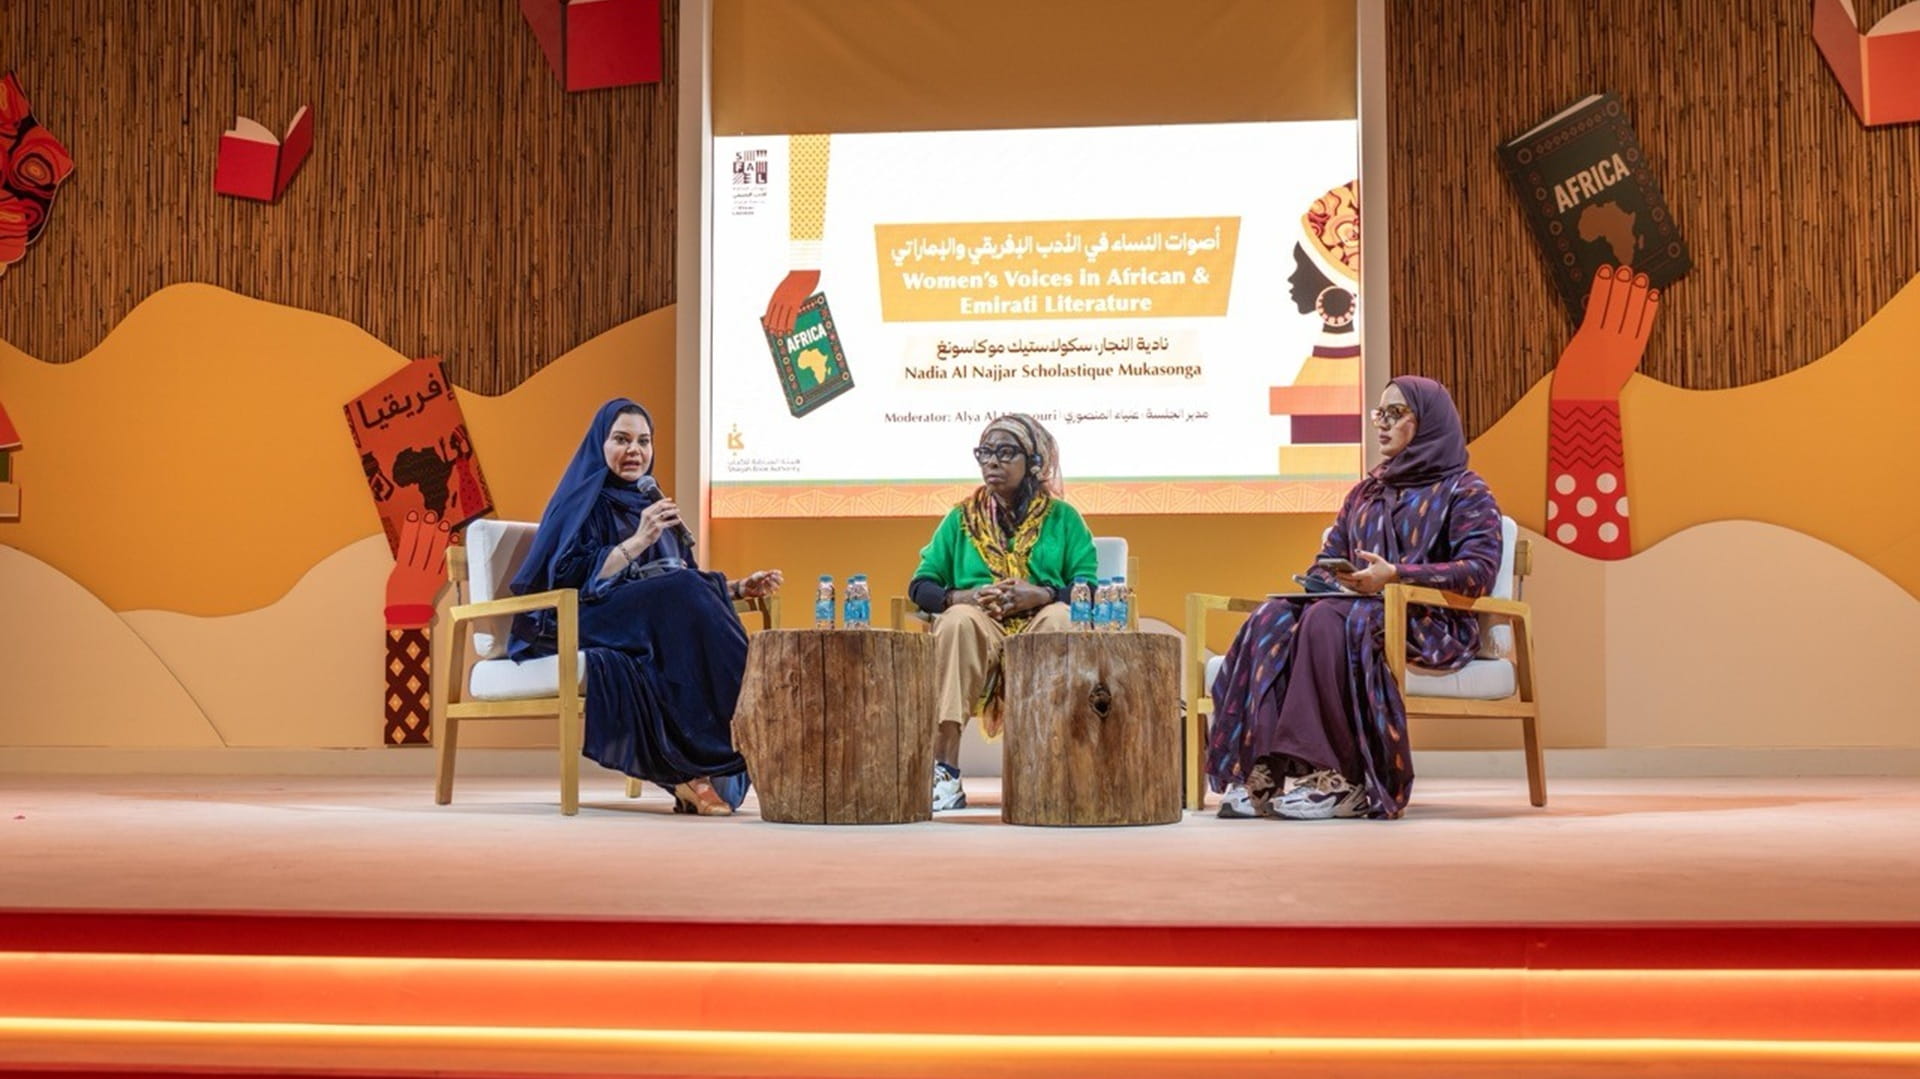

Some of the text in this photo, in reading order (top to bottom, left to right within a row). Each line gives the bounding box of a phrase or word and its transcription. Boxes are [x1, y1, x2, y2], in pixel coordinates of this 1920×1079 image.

[1553, 152, 1631, 214] AFRICA
[890, 224, 1222, 267] أصوات النساء في الأدب الإفريقي والإماراتي
[902, 265, 1210, 290] Women’s Voices in African &
[960, 293, 1153, 314] Emirati Literature
[785, 323, 828, 354] AFRICA
[937, 338, 1005, 361] موكاسونغ
[1007, 337, 1093, 357] سكولاستيك
[1136, 336, 1169, 355] نادية
[904, 362, 1202, 382] Nadia Al Najjar Scholastique Mukasonga
[356, 361, 455, 430] إفريقيا
[884, 411, 951, 423] Moderator:
[955, 410, 981, 424] Alya
